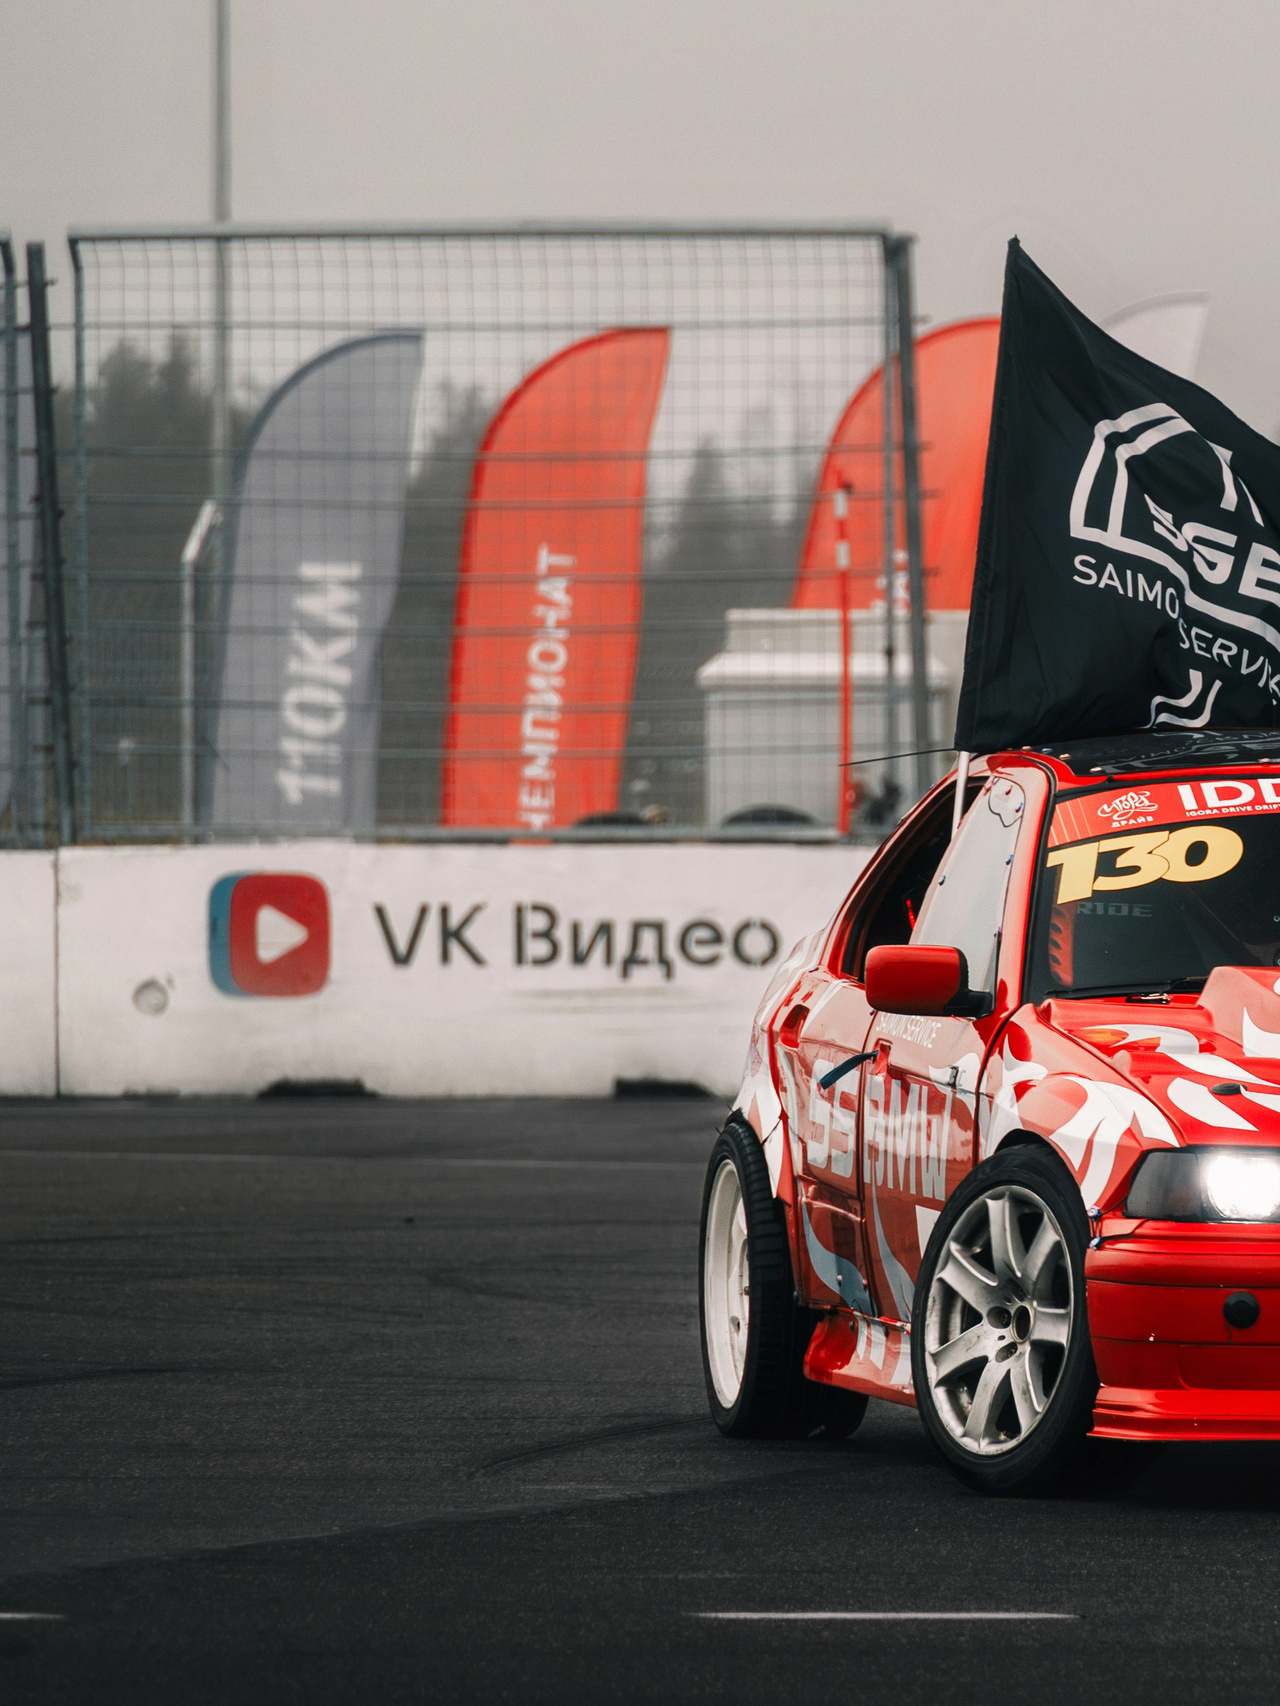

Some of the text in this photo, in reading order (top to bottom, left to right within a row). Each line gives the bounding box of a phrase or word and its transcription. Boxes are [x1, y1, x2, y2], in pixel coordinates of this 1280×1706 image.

[1073, 554, 1180, 619] SAIMO
[1111, 815, 1154, 828] ДРАЙВ
[1186, 809, 1220, 817] IGORA
[1222, 805, 1253, 813] DRIVE
[1046, 825, 1244, 905] 130
[373, 902, 782, 981] VK Видео
[902, 1014, 942, 1048] SERVICE
[807, 1058, 953, 1201] SSBMW
